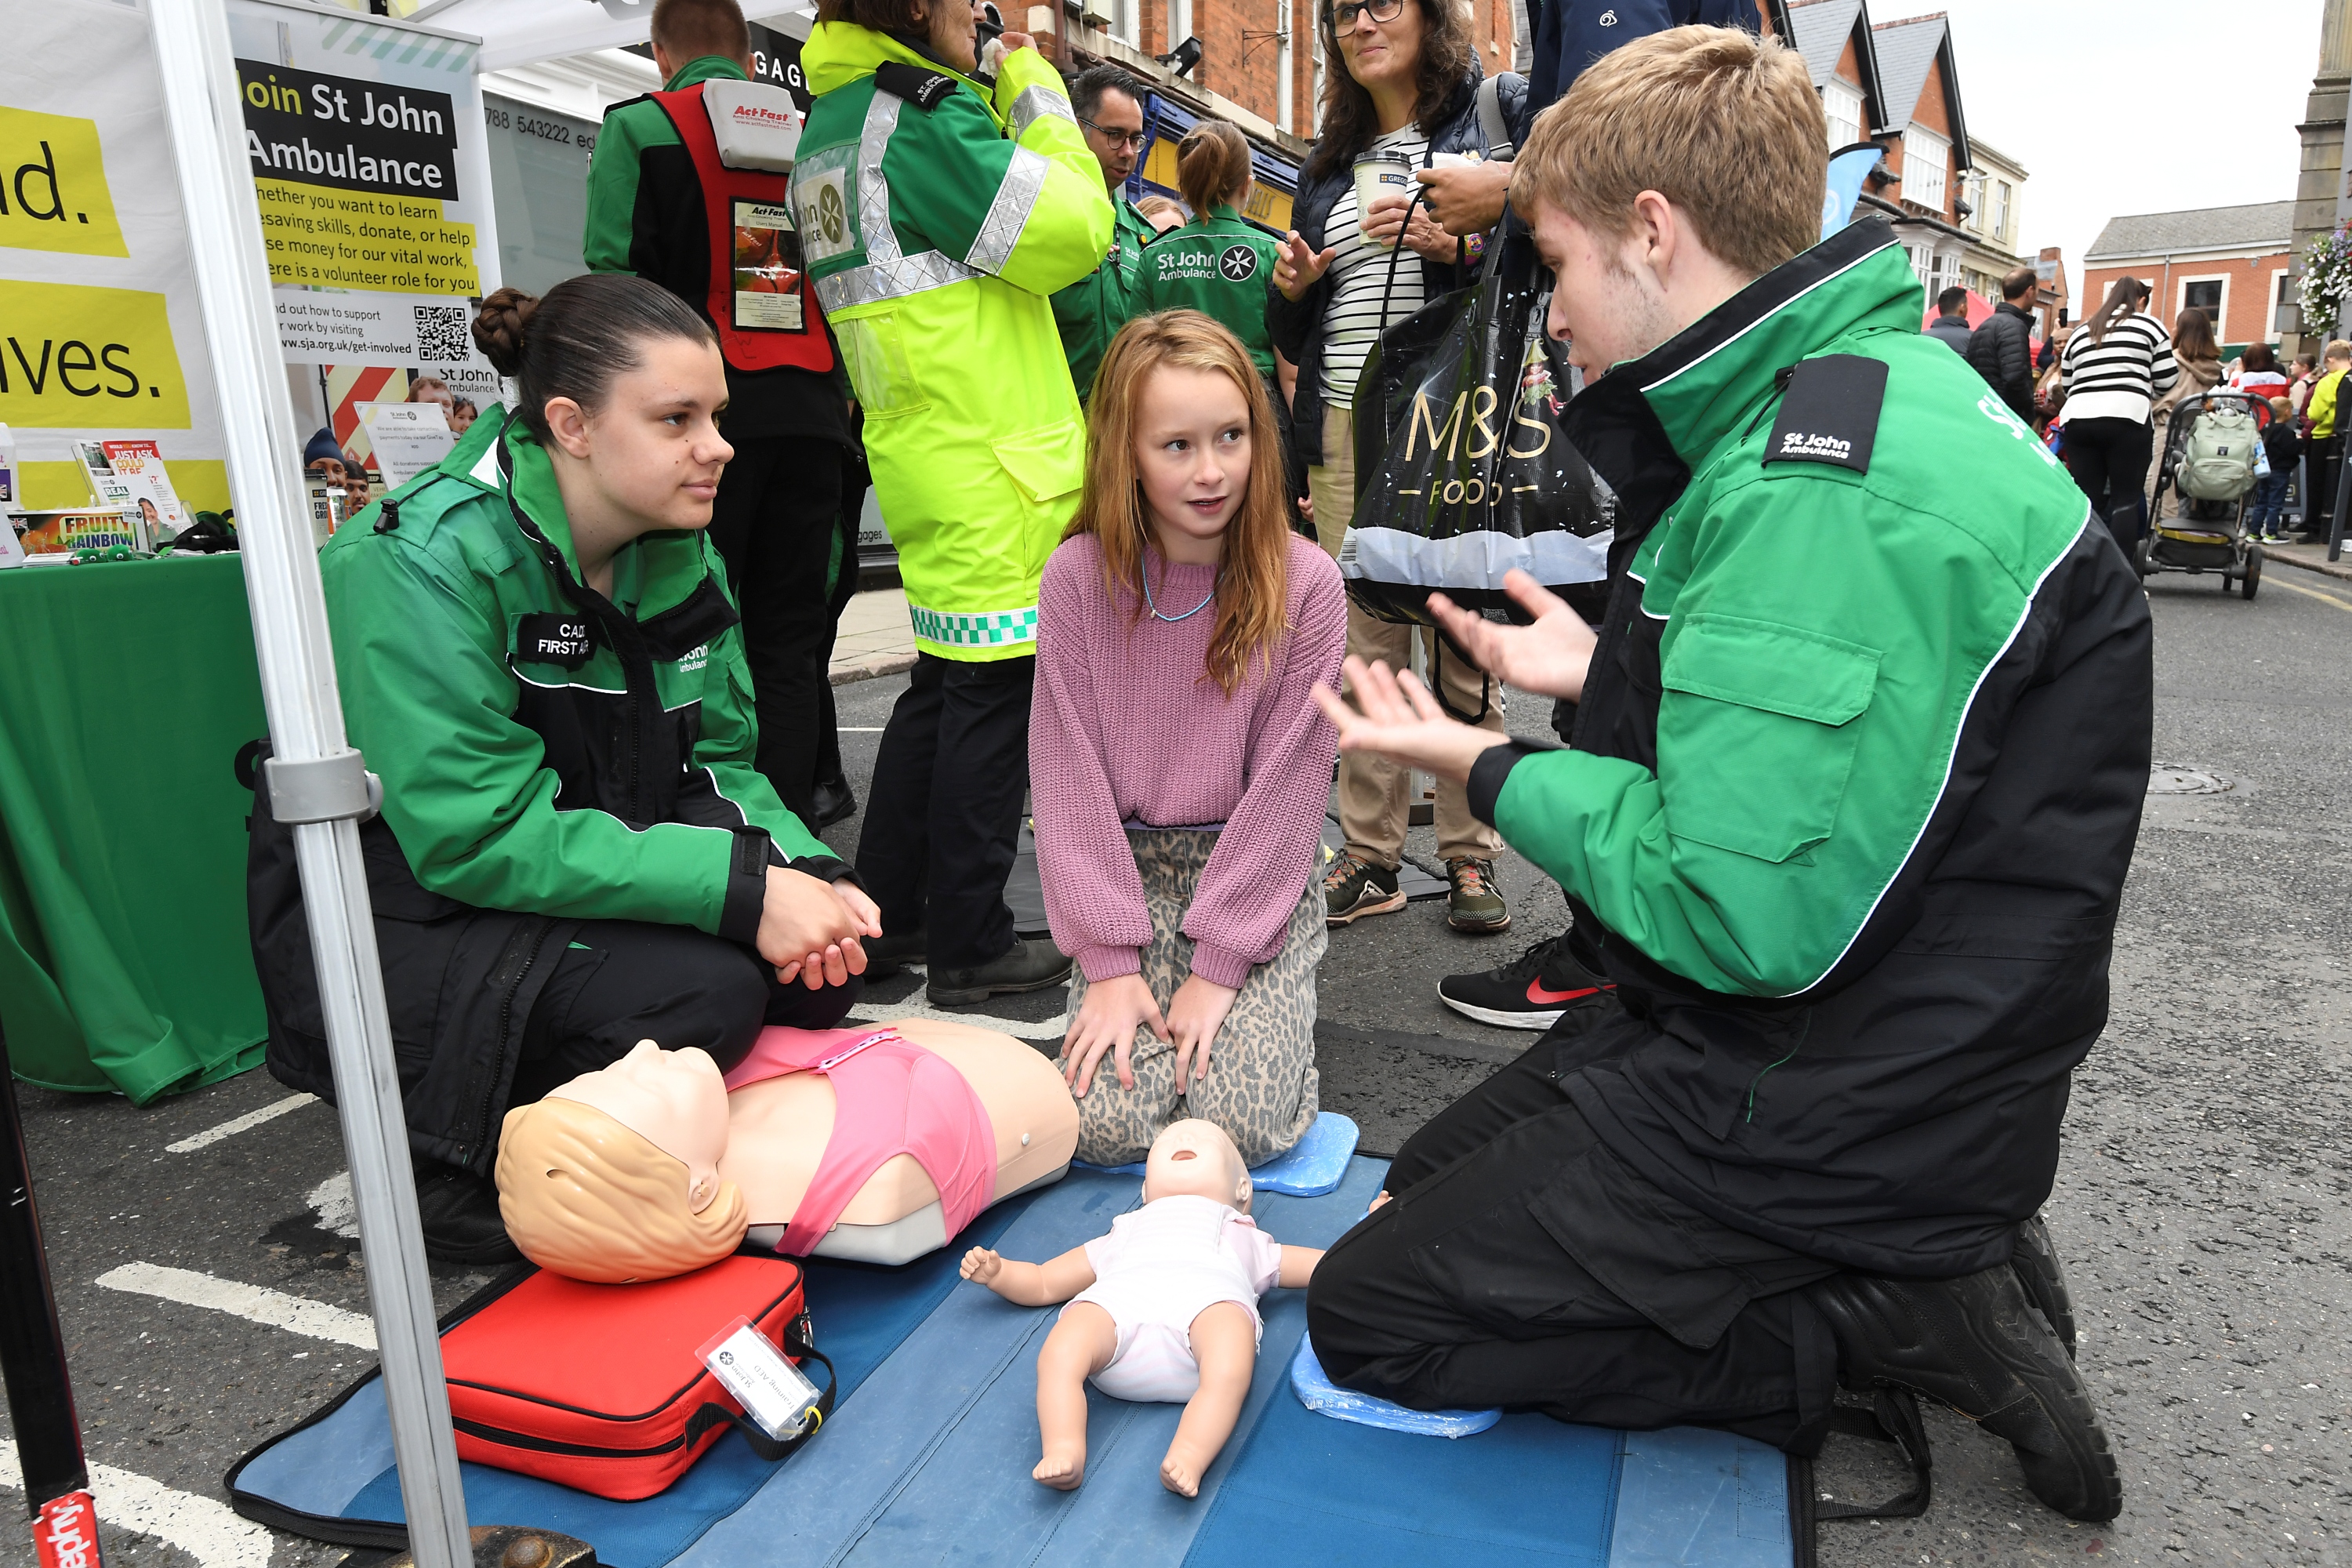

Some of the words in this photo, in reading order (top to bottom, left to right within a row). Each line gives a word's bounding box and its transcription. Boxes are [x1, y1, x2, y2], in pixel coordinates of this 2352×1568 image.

[753, 50, 810, 91] GAG
[311, 83, 350, 123] St
[361, 91, 444, 135] John
[734, 105, 758, 117] Act
[760, 108, 789, 122] Fast
[485, 107, 510, 129] 788
[517, 115, 571, 144] 543222
[576, 134, 597, 151] ed
[246, 129, 443, 189] Ambulance
[0, 140, 89, 224] d.
[1388, 175, 1408, 185] GREGG
[256, 183, 305, 205] hether
[309, 195, 335, 210] you
[338, 199, 375, 215] want
[379, 201, 394, 216] to
[399, 201, 437, 220] learn
[752, 206, 768, 216] Act
[317, 216, 355, 238] skills,
[359, 221, 416, 243] donate,
[419, 230, 436, 242] or
[439, 228, 470, 248] help
[266, 238, 285, 251] se
[289, 240, 335, 260] money
[338, 242, 358, 260] for
[362, 249, 387, 262] our
[390, 249, 423, 264] vital
[427, 252, 467, 270] work,
[1157, 252, 1175, 270] St
[1177, 251, 1216, 267] John
[268, 263, 292, 276] ere
[295, 262, 308, 278] is
[311, 267, 320, 279] a
[322, 265, 387, 285] volunteer
[392, 271, 421, 287] role
[424, 273, 445, 289] for
[449, 278, 475, 292] you
[1158, 267, 1216, 281] Ambulance
[289, 304, 307, 315] out
[309, 304, 330, 317] how
[332, 307, 343, 318] to
[344, 310, 381, 322] support
[287, 320, 314, 333] work
[315, 321, 328, 336] by
[329, 323, 365, 338] visiting
[440, 368, 456, 381] St
[459, 368, 493, 383] John
[449, 383, 495, 393] mbulance
[1405, 384, 1552, 463] M&S
[1783, 432, 1804, 445] St
[1805, 434, 1851, 452] John
[114, 449, 134, 459] JUST
[136, 449, 154, 459] ASK
[1780, 445, 1849, 459] Ambulance
[115, 459, 145, 469] COULD
[104, 486, 129, 495] REAL
[1428, 477, 1503, 507] FOOD
[314, 502, 328, 510] FRES
[315, 510, 328, 520] GRO
[65, 516, 129, 533] FRUITY
[66, 533, 133, 549] RAINBOW
[559, 623, 586, 639] CAD
[538, 638, 579, 655] FIRST
[753, 1364, 771, 1382] AED
[771, 1378, 795, 1411] Training
